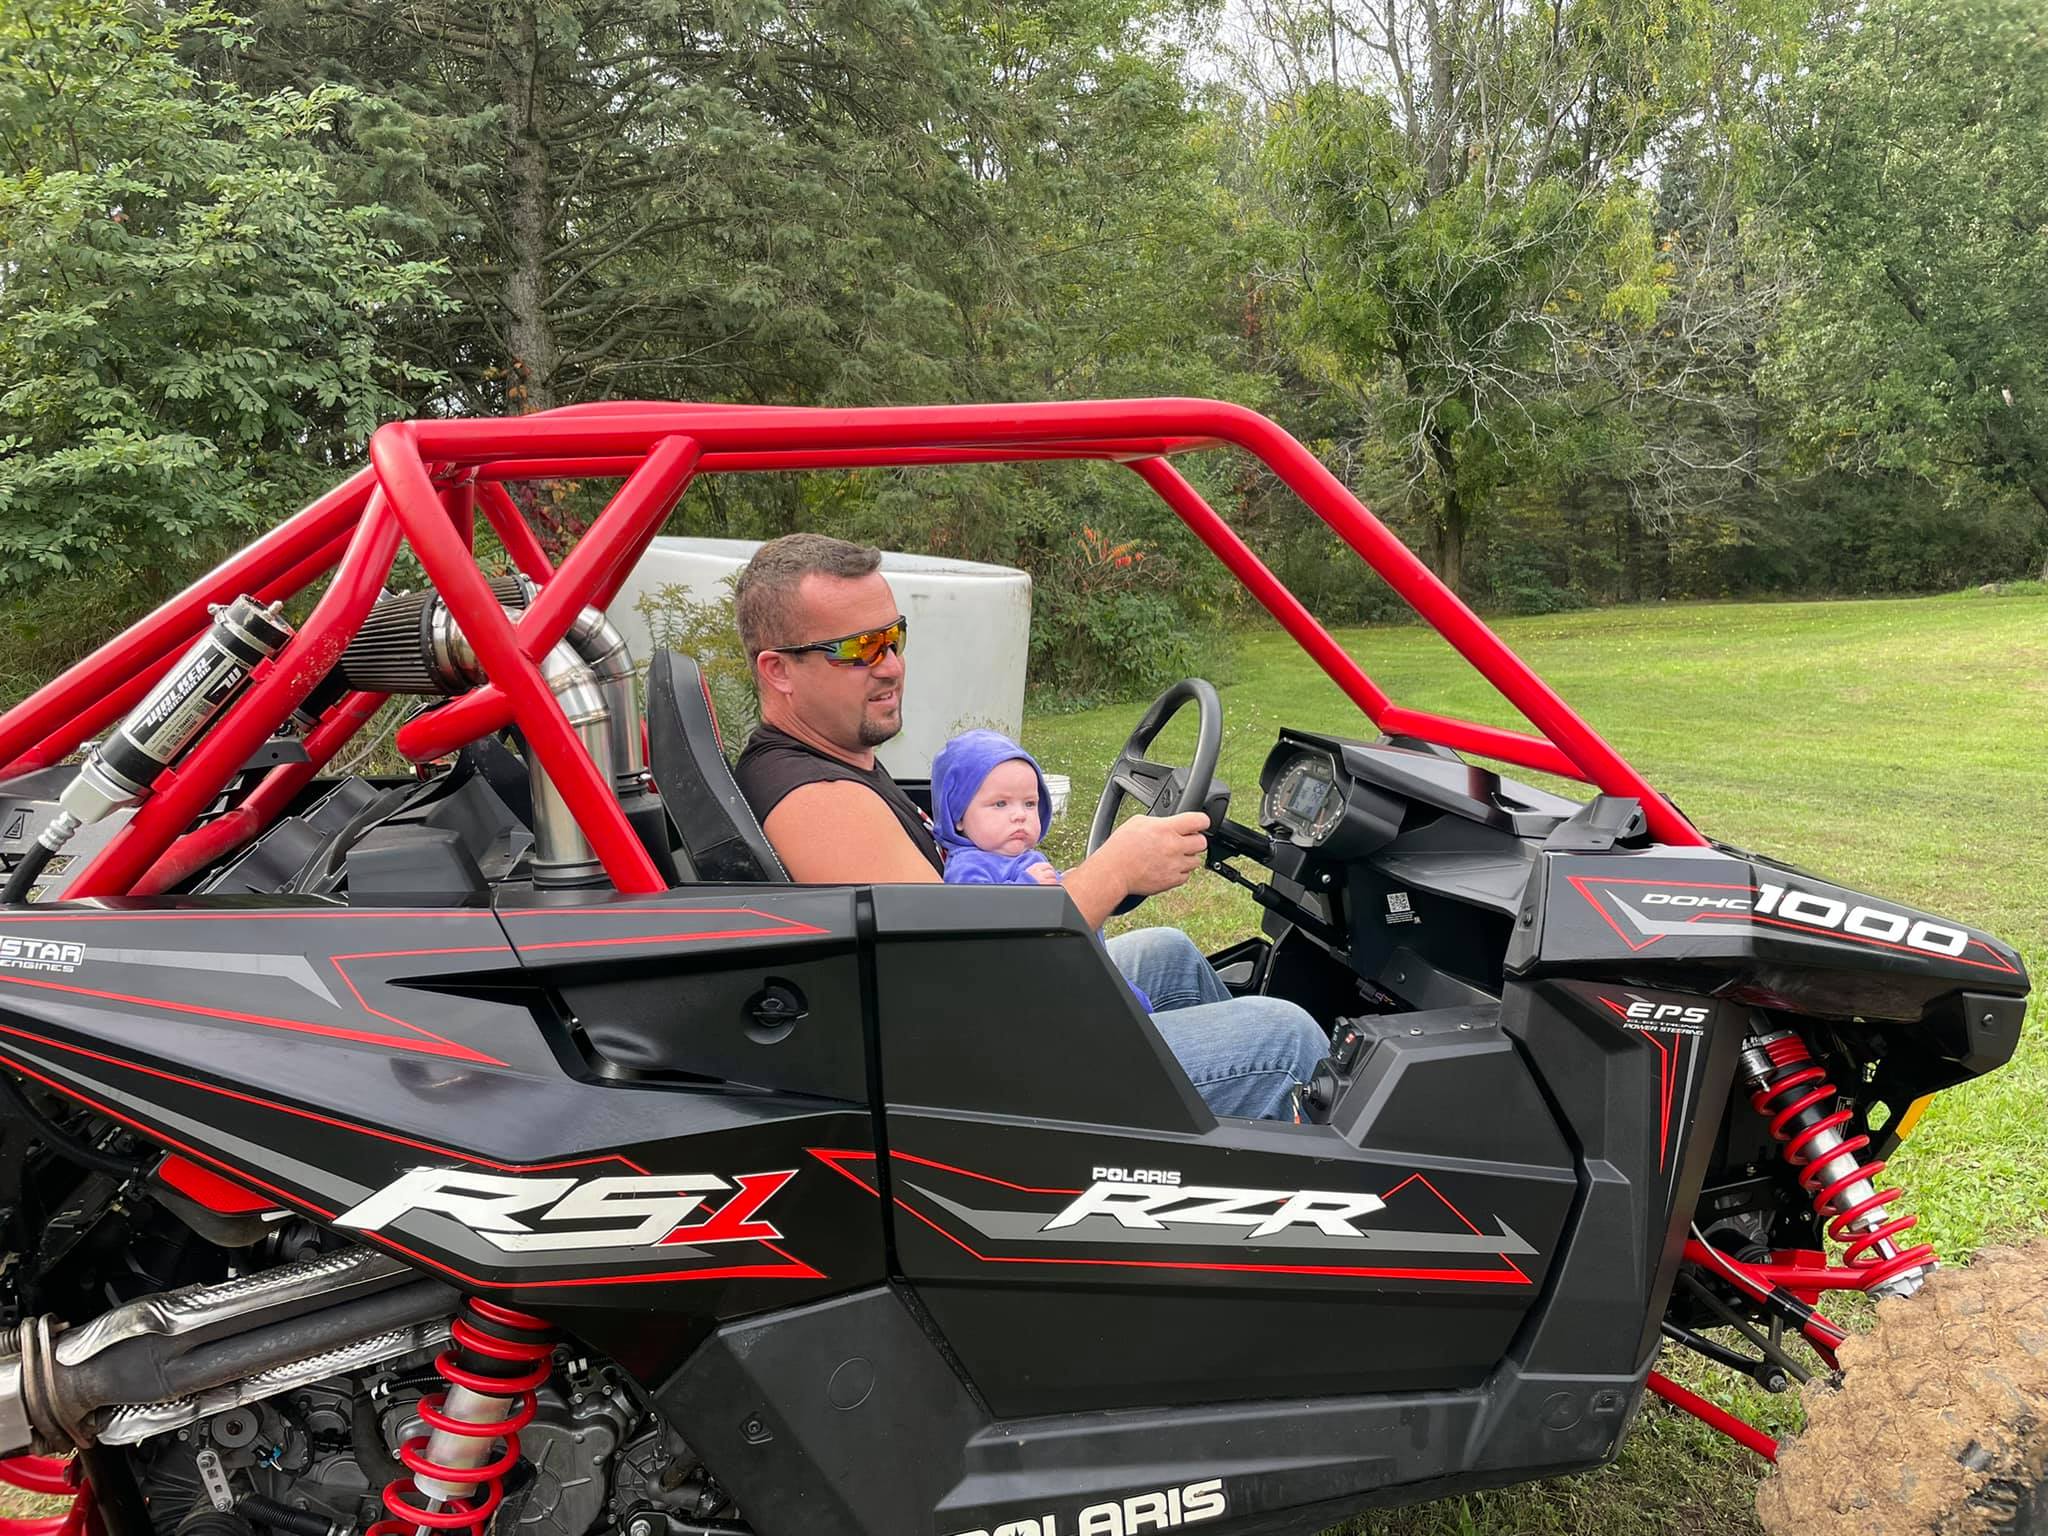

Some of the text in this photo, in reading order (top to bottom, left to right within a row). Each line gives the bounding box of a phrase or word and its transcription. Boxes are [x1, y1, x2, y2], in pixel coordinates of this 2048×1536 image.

[141, 656, 212, 730] WALKER
[1642, 883, 1969, 957] DOHC 1000
[0, 940, 82, 963] STAR
[1623, 1022, 1705, 1037] POWER STEERING
[1626, 1002, 1710, 1024] EPS
[1093, 1167, 1182, 1185] POLARIS
[332, 1166, 799, 1252] RS1
[1038, 1181, 1387, 1240] RZR
